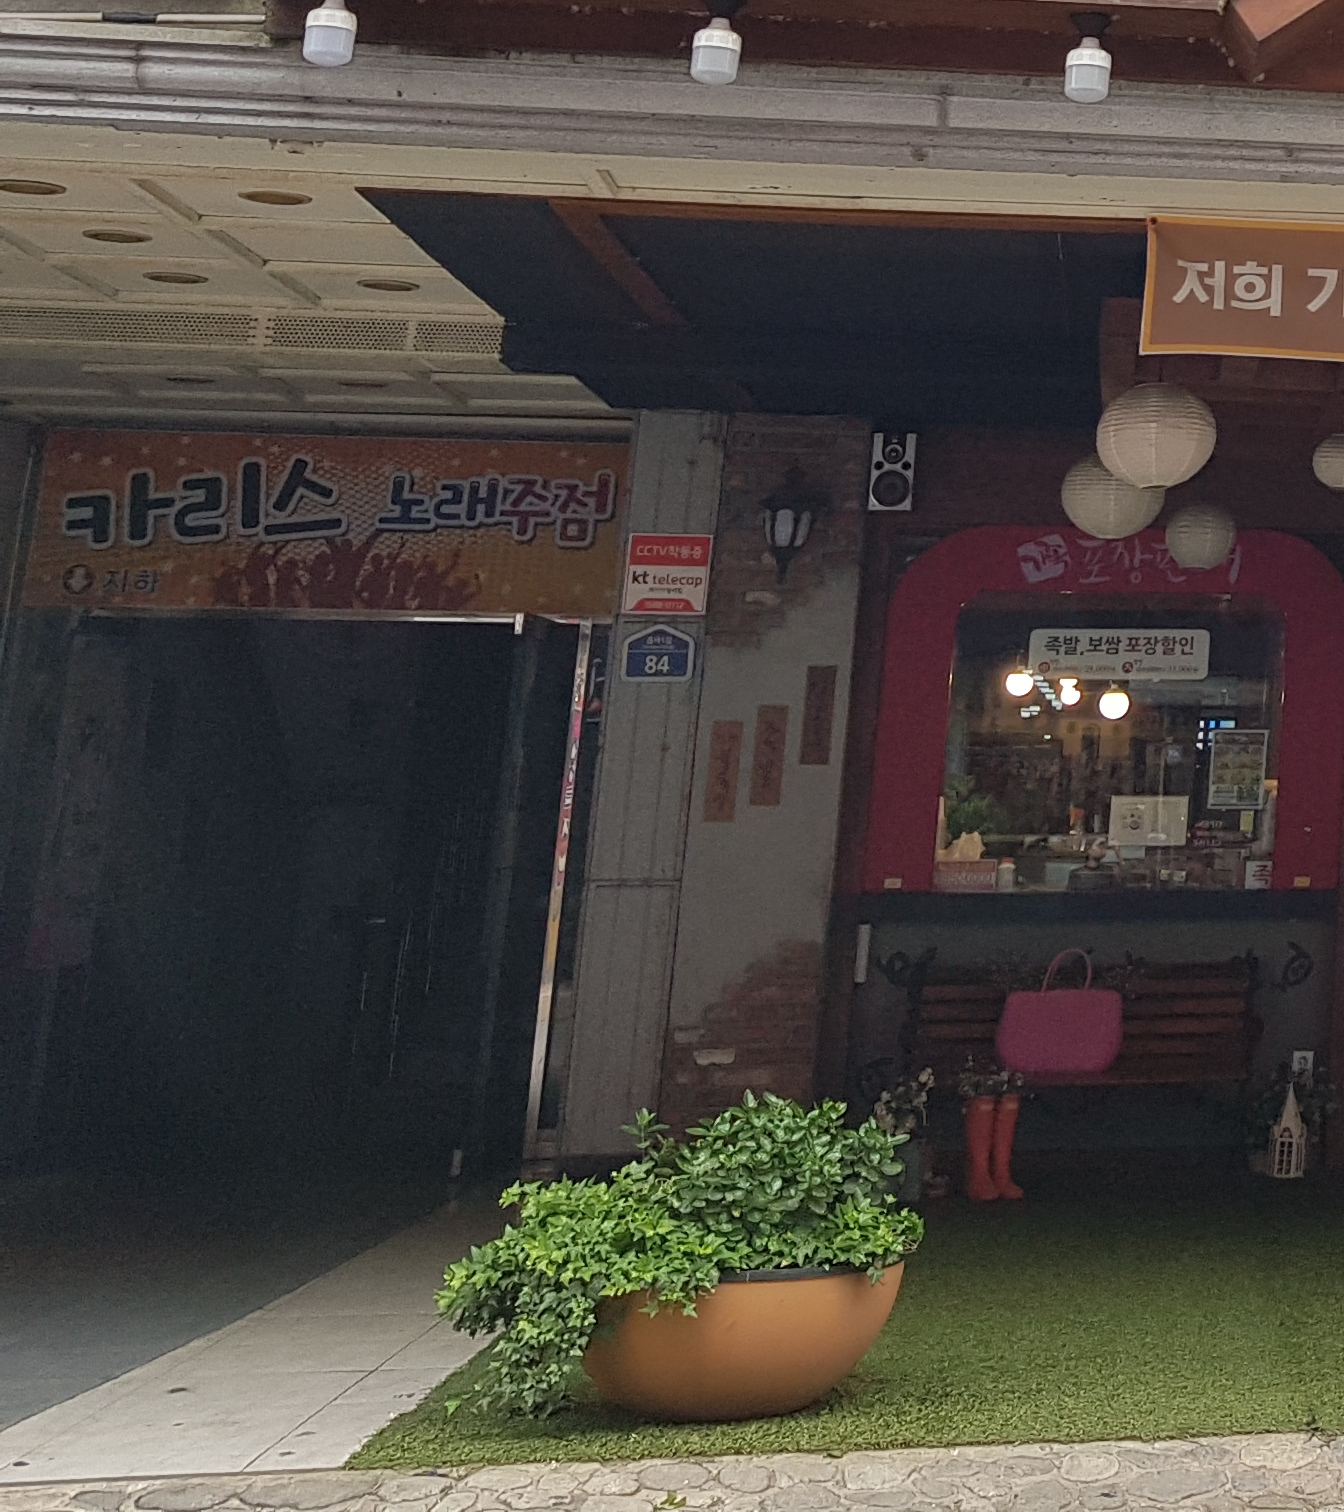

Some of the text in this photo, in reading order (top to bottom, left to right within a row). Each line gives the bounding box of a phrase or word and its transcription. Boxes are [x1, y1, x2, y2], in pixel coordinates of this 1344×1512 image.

[1172, 259, 1284, 317] 저희
[62, 455, 617, 548] 카리스 노래주점
[102, 568, 160, 593] 지하
[632, 571, 650, 585] kt
[1123, 635, 1195, 656] 포장할인
[644, 654, 670, 675] 84
